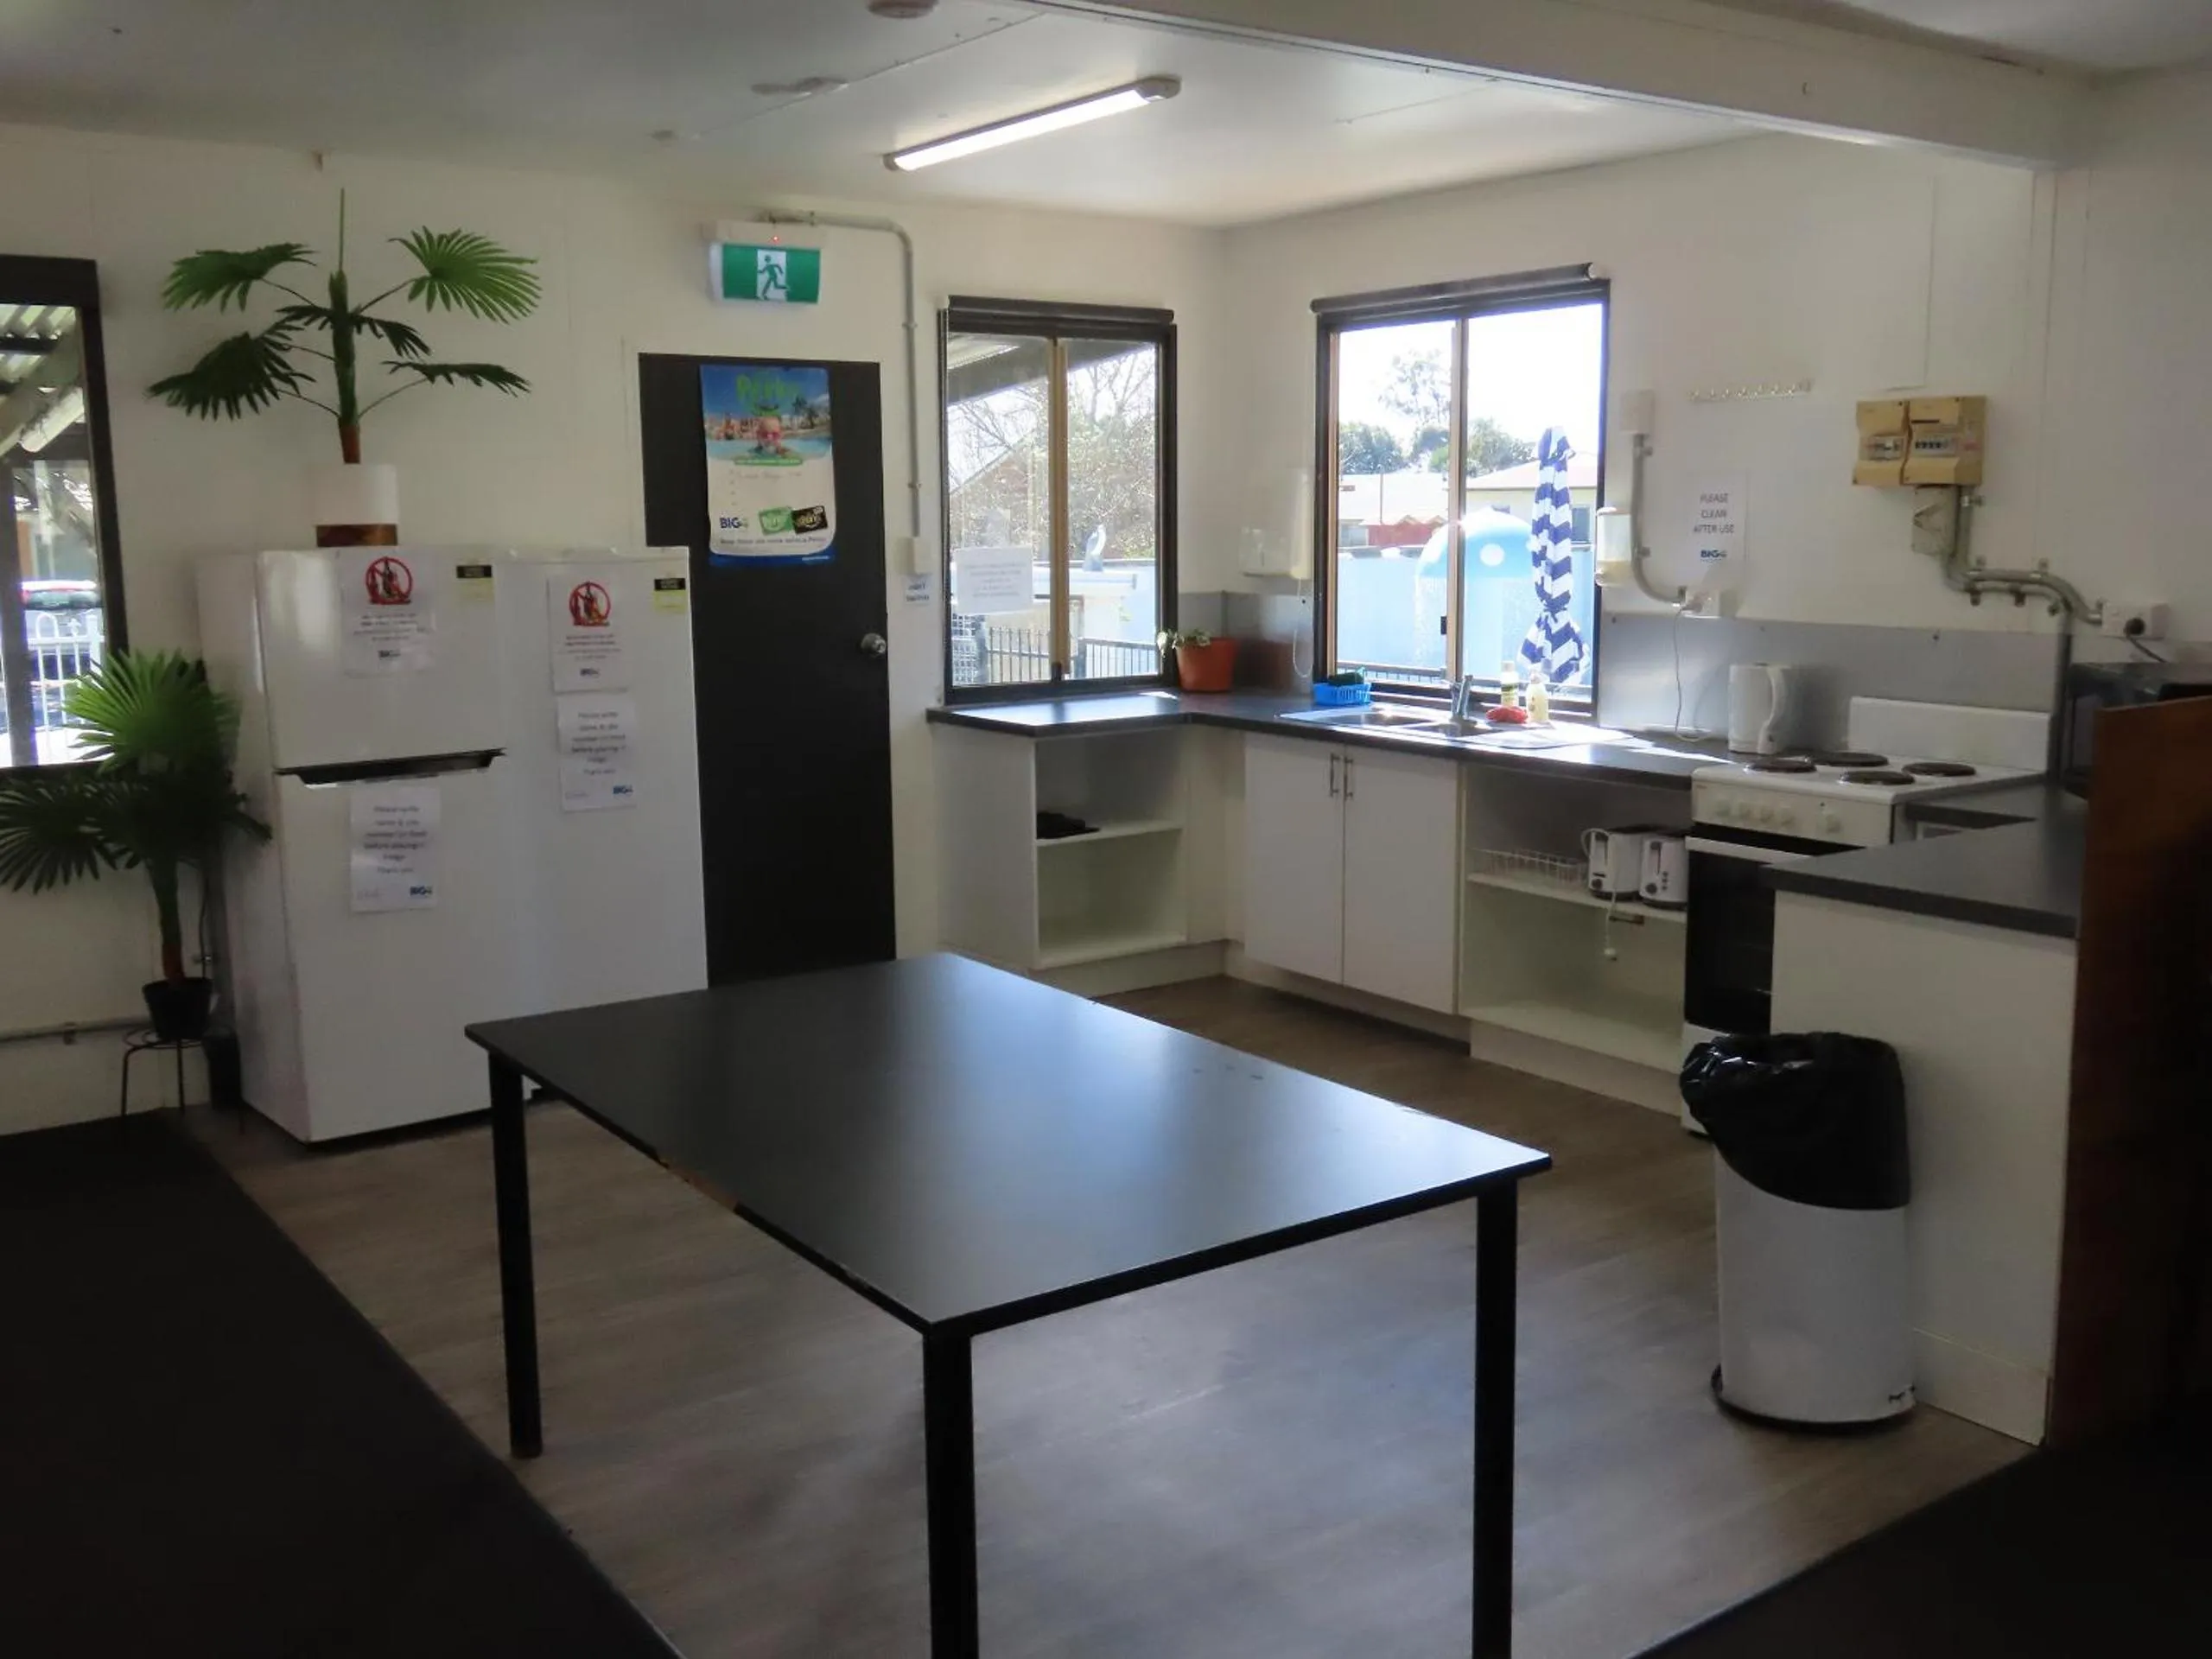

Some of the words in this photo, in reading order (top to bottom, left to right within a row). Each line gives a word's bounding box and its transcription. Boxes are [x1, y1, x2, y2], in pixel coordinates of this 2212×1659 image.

[1700, 493, 1728, 504] PLEASE
[1700, 509, 1727, 518] CLEAN
[1694, 524, 1718, 534] AFTER
[1719, 524, 1734, 534] USE
